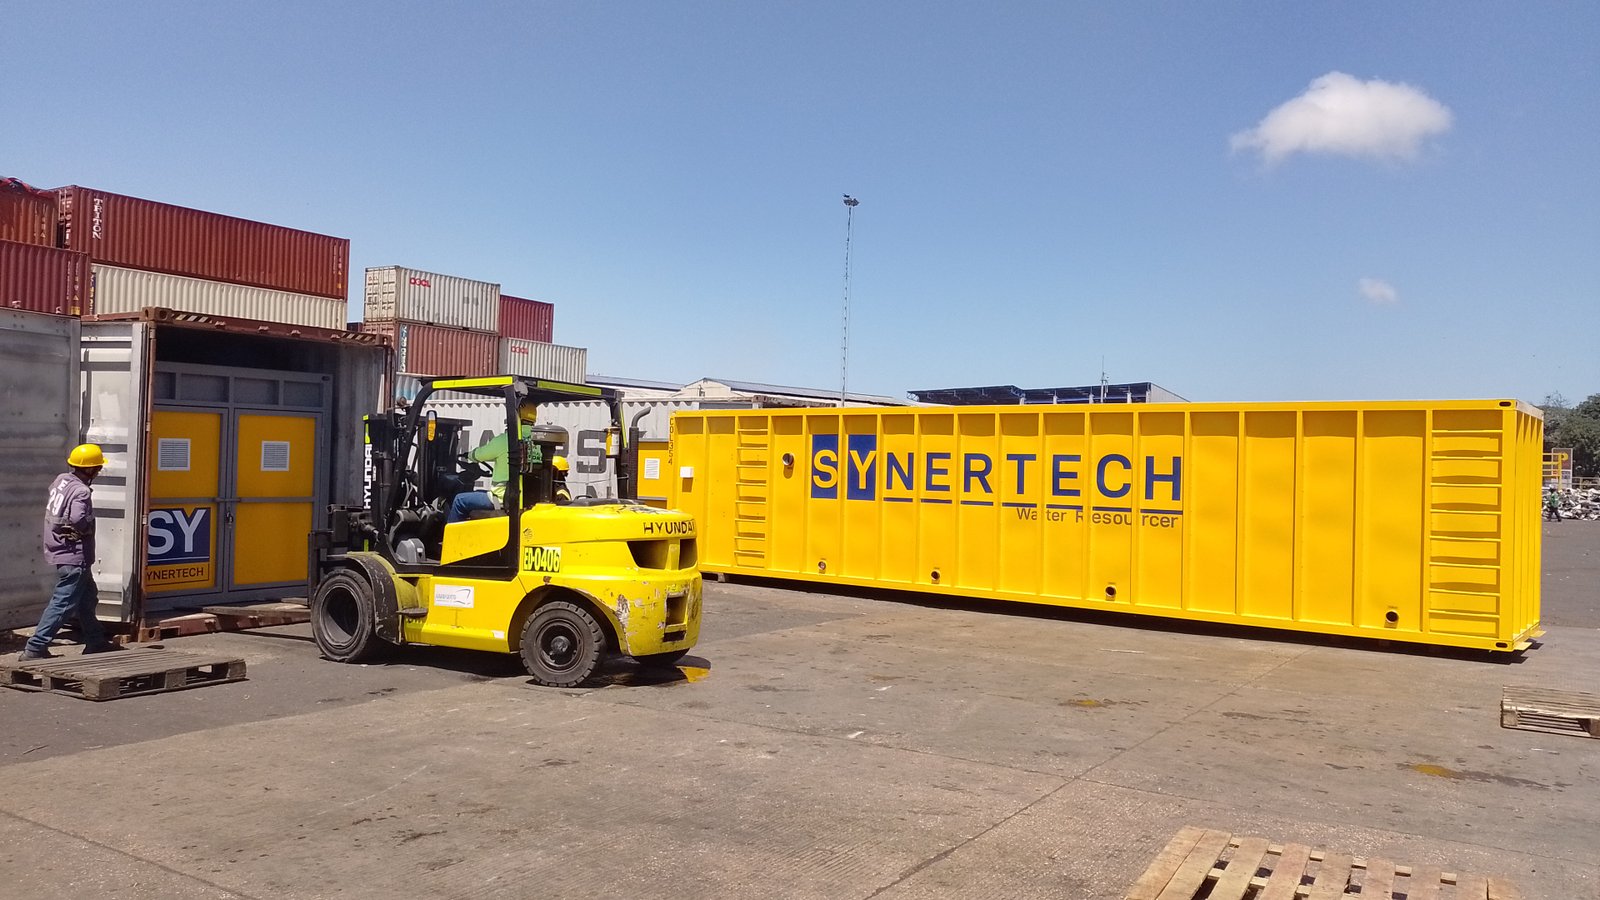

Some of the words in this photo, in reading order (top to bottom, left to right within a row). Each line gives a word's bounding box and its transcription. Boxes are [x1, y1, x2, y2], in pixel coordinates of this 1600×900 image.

[92, 198, 103, 240] TRITON
[363, 443, 373, 510] HYUNDAI
[812, 449, 1182, 501] SYNERTECH
[46, 487, 65, 516] 29
[1016, 507, 1067, 522] Water
[1075, 510, 1179, 528] Resourcer
[148, 509, 207, 555] SY
[146, 567, 204, 580] YNERTECH
[523, 547, 560, 572] ED-0406
